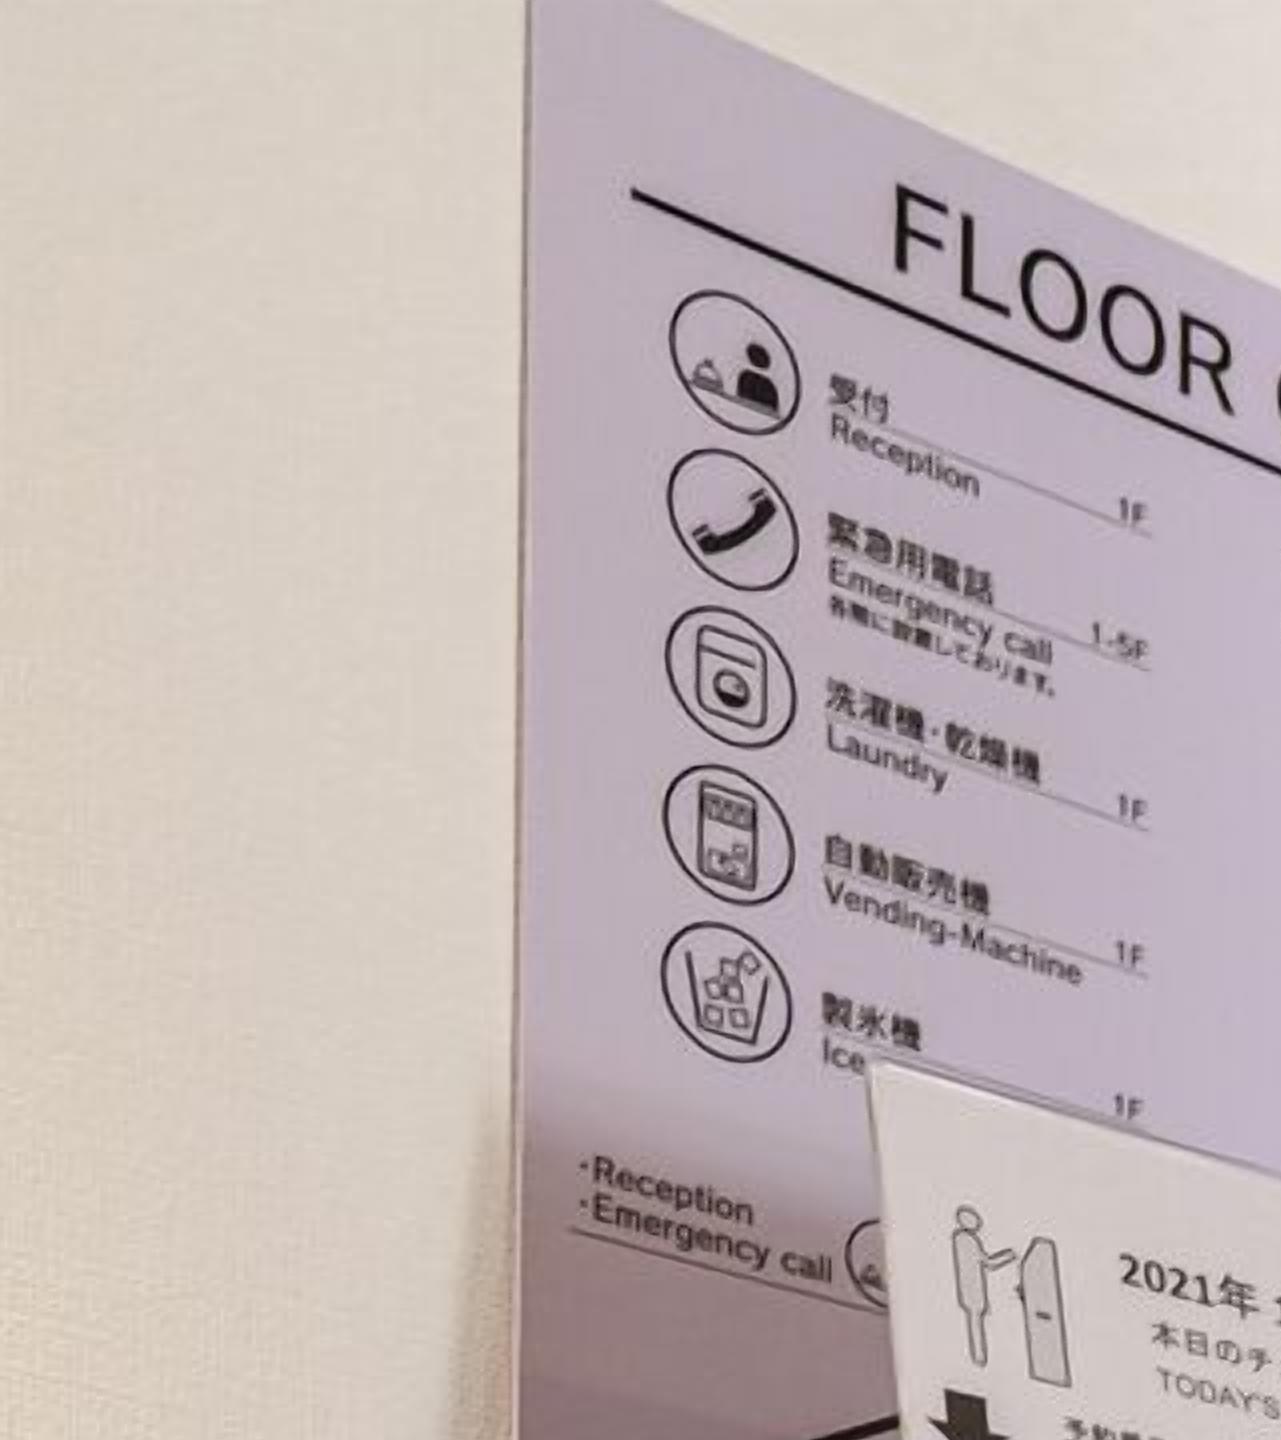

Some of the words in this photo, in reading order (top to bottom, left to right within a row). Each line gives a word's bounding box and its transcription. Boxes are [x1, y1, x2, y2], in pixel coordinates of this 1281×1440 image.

[893, 183, 1235, 417] FLOOR
[828, 373, 890, 424] 受付
[830, 412, 981, 498] Reception
[1117, 496, 1148, 527] 1F
[827, 512, 994, 606] 緊急用電話
[829, 556, 993, 650] Emergency
[1004, 630, 1053, 667] call
[1091, 620, 1148, 660] 1-5F
[826, 722, 948, 795] Laundry
[1117, 792, 1149, 821] 1F
[824, 833, 990, 917] 自動販売機
[824, 876, 1082, 985] Vending-Machine
[1114, 940, 1144, 969] 1F
[823, 1038, 866, 1075] Ice
[1113, 1092, 1143, 1120] 1F
[781, 1245, 833, 1284] call
[1154, 1366, 1281, 1421] TODAY'S
